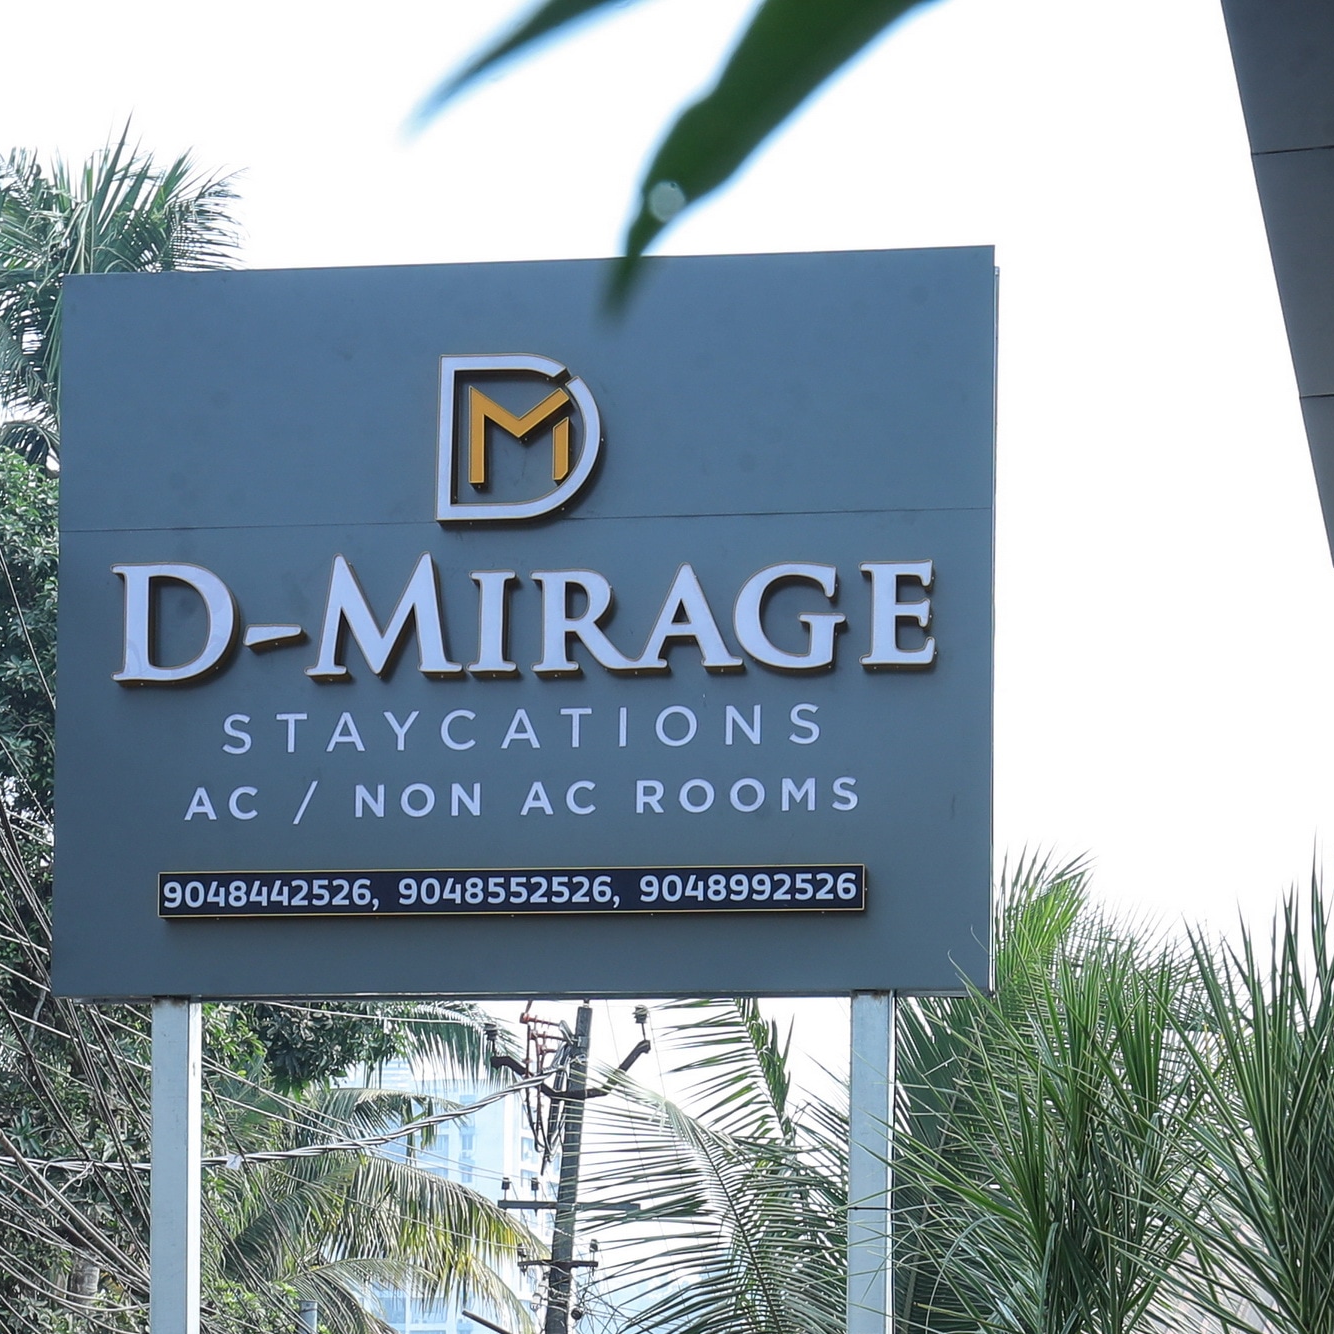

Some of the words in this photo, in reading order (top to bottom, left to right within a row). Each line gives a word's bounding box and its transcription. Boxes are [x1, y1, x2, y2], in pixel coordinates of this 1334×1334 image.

[222, 703, 821, 755] STAYCATIONS
[184, 787, 258, 822] AC
[354, 782, 482, 819] NON
[520, 781, 596, 817] AC
[636, 777, 859, 814] ROOMS
[163, 879, 379, 911] 9048442526,
[398, 876, 621, 909] 9048552526,
[639, 872, 857, 903] 9048992526
